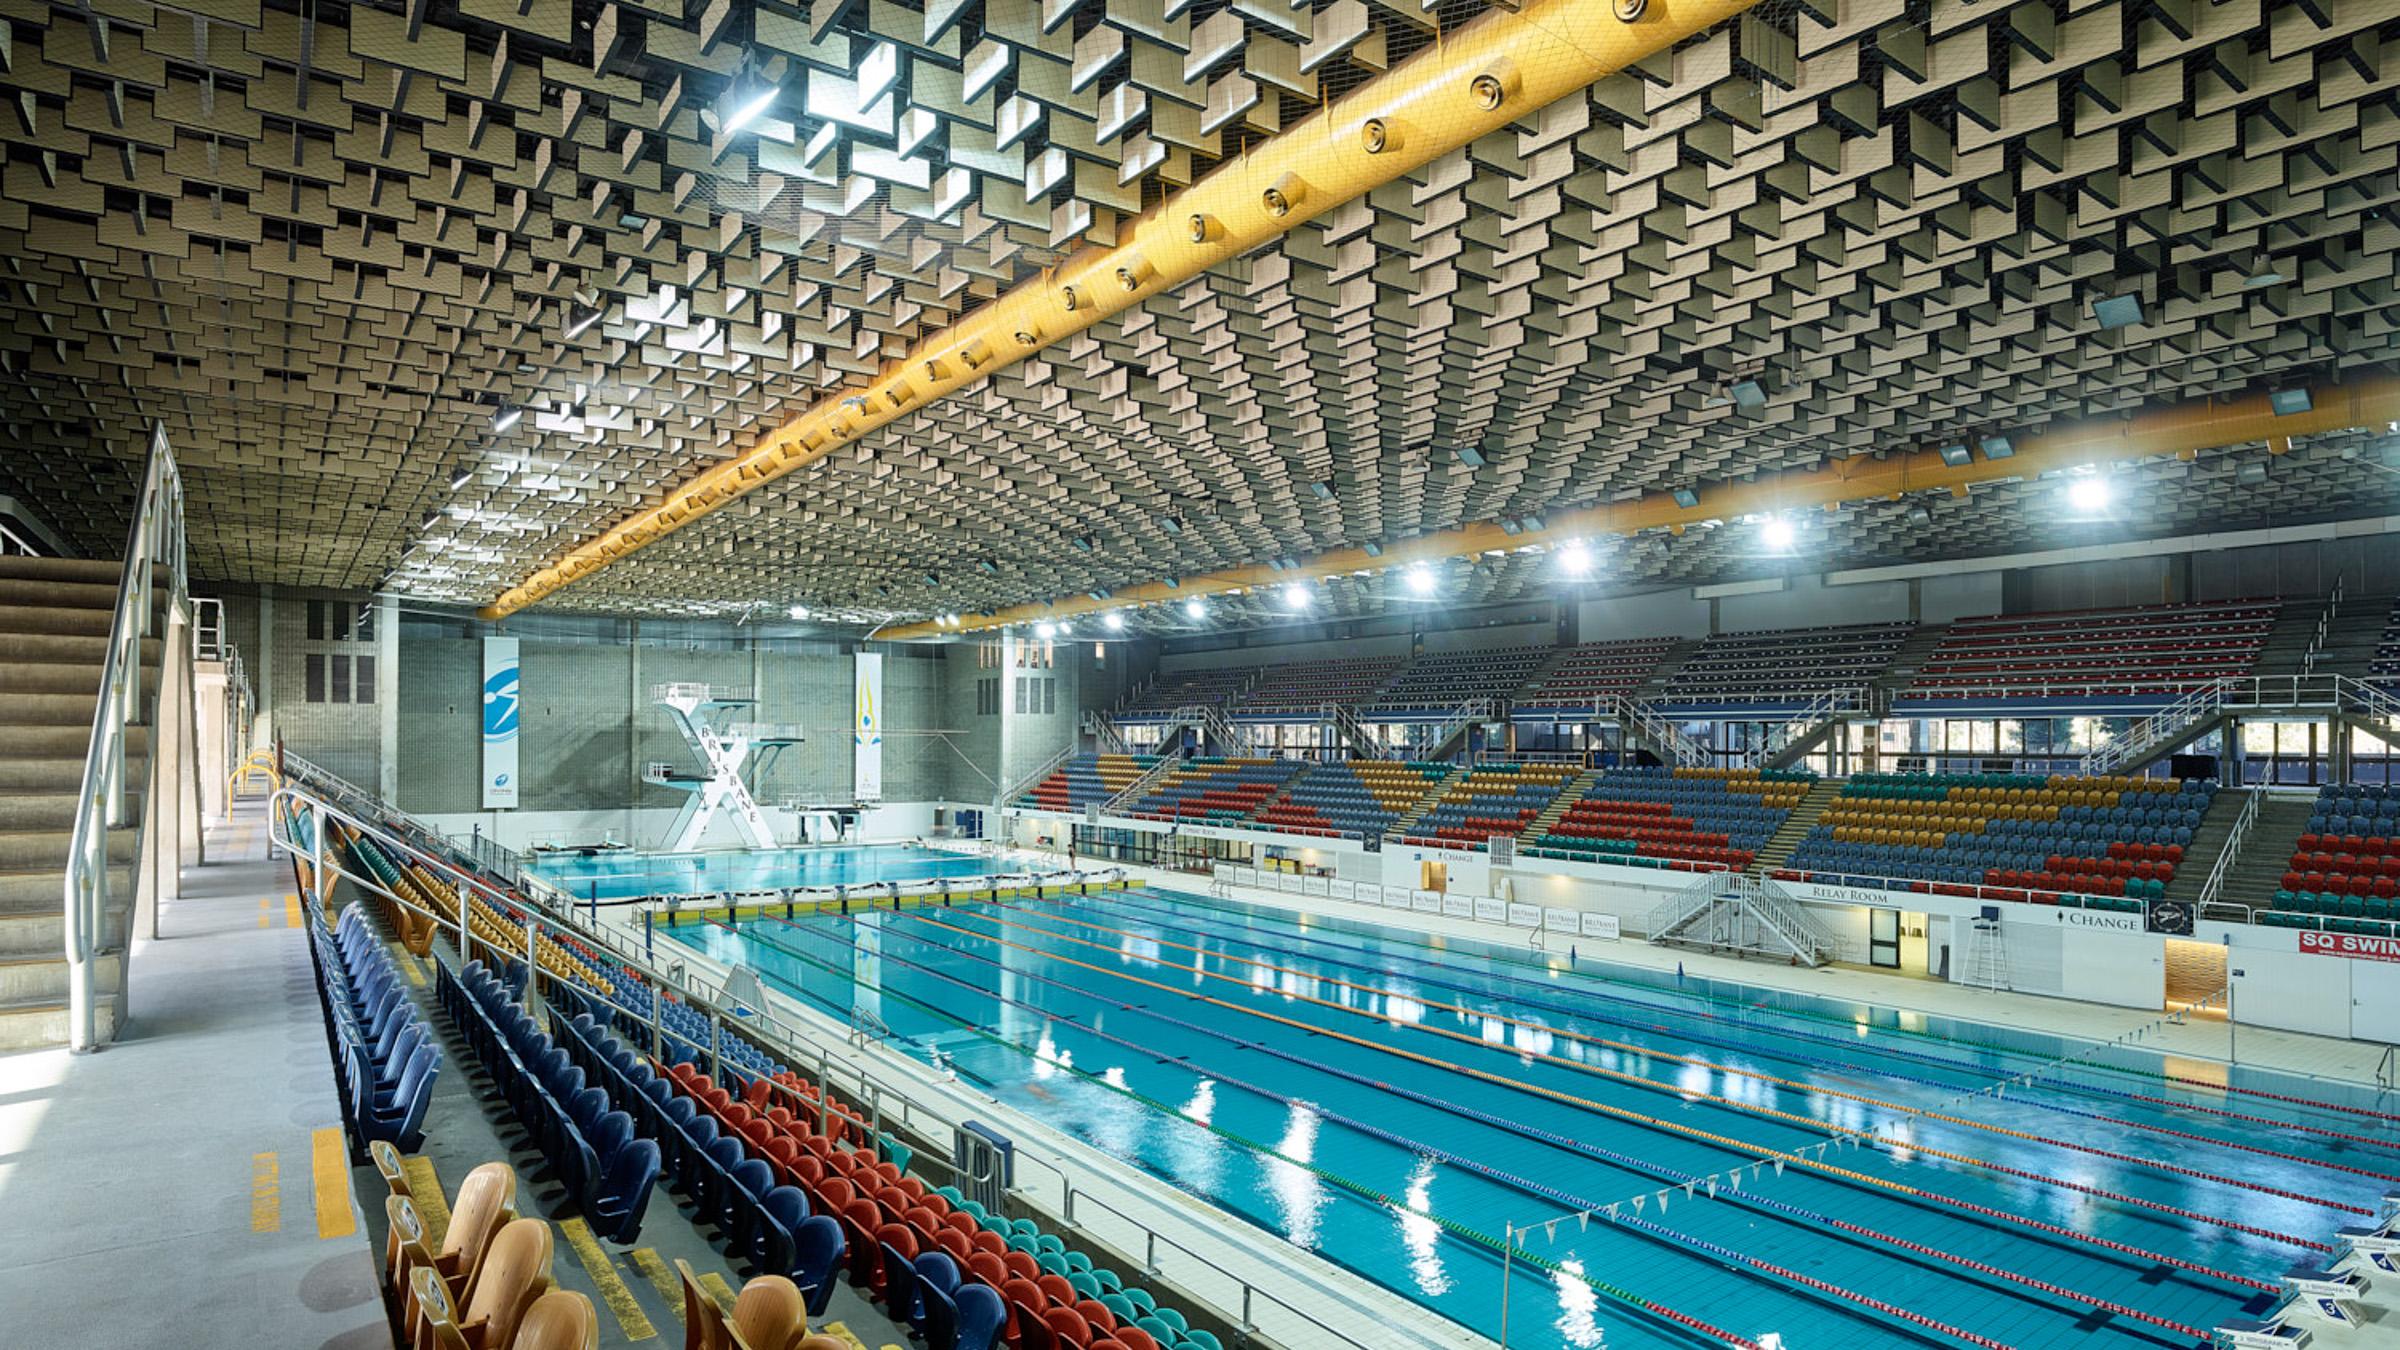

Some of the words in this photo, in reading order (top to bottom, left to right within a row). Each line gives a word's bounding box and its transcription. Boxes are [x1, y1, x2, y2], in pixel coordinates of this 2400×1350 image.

[701, 727, 757, 823] BRISBANE
[1813, 886, 1848, 899] RELAY
[1850, 890, 1888, 903] ROOM
[2069, 912, 2138, 931] CHANGE
[2303, 933, 2335, 949] SQ
[2325, 1302, 2336, 1315] 3
